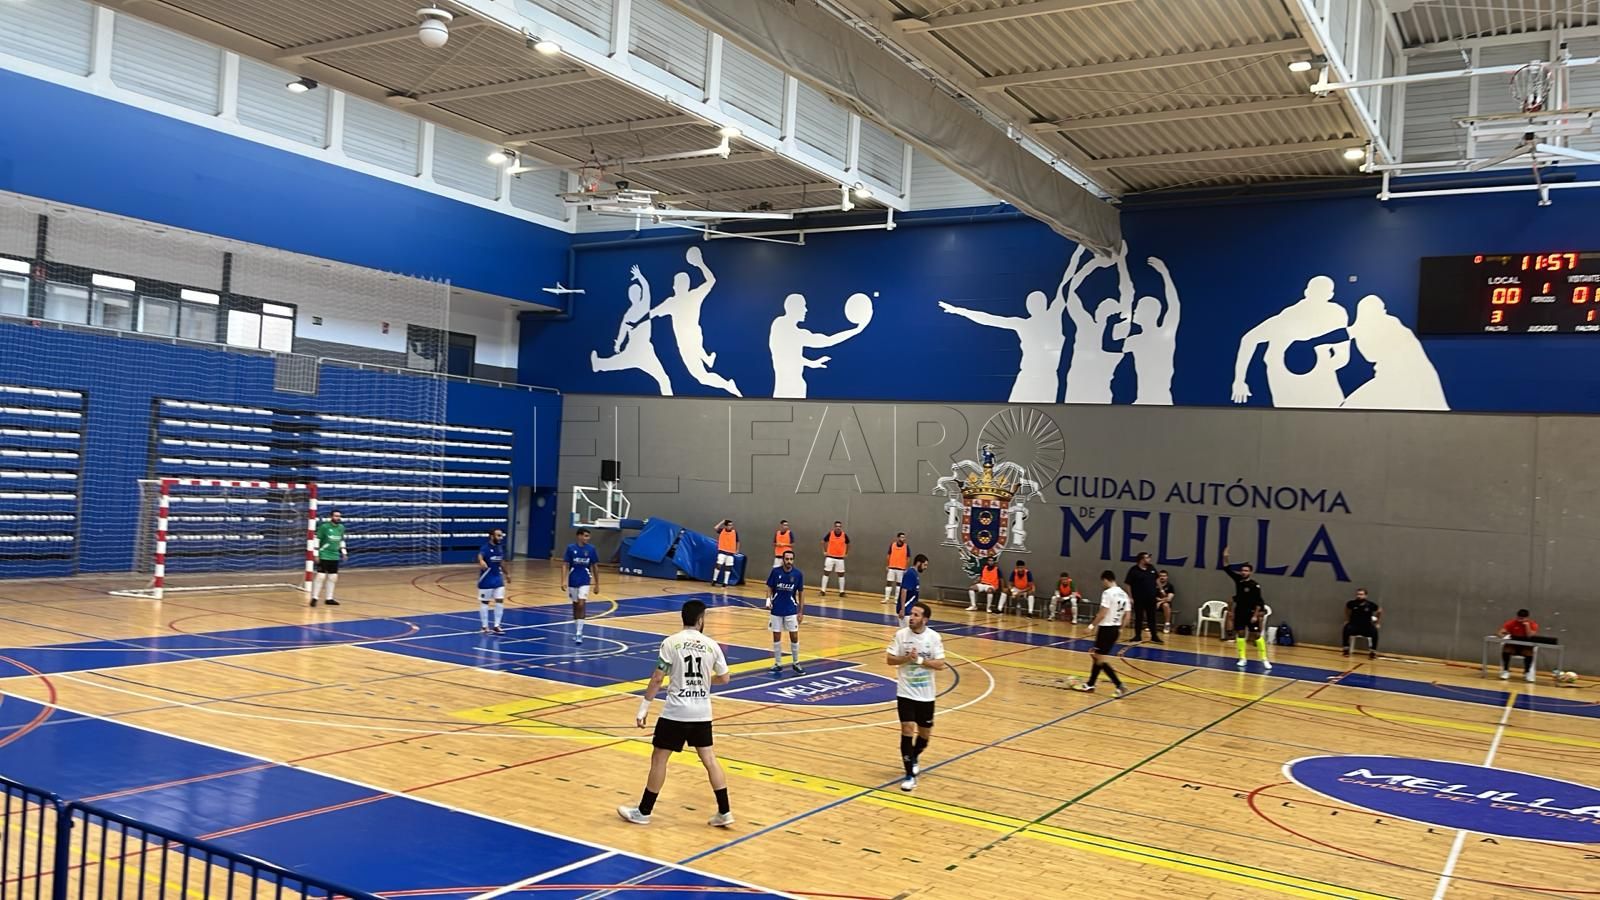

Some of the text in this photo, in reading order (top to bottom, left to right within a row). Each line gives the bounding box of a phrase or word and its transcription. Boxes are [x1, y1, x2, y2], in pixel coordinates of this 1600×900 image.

[1521, 253, 1577, 270] 11:57
[1488, 276, 1521, 285] LOCAL
[1491, 287, 1521, 305] 00
[1490, 310, 1503, 323] 3
[1056, 475, 1352, 514] CIUDAD AUTÓNOMA
[1079, 506, 1096, 518] DE
[1060, 506, 1352, 583] MELILLA
[684, 655, 703, 678] 11
[765, 676, 866, 699] MELILLA
[1433, 793, 1480, 805] DEL
